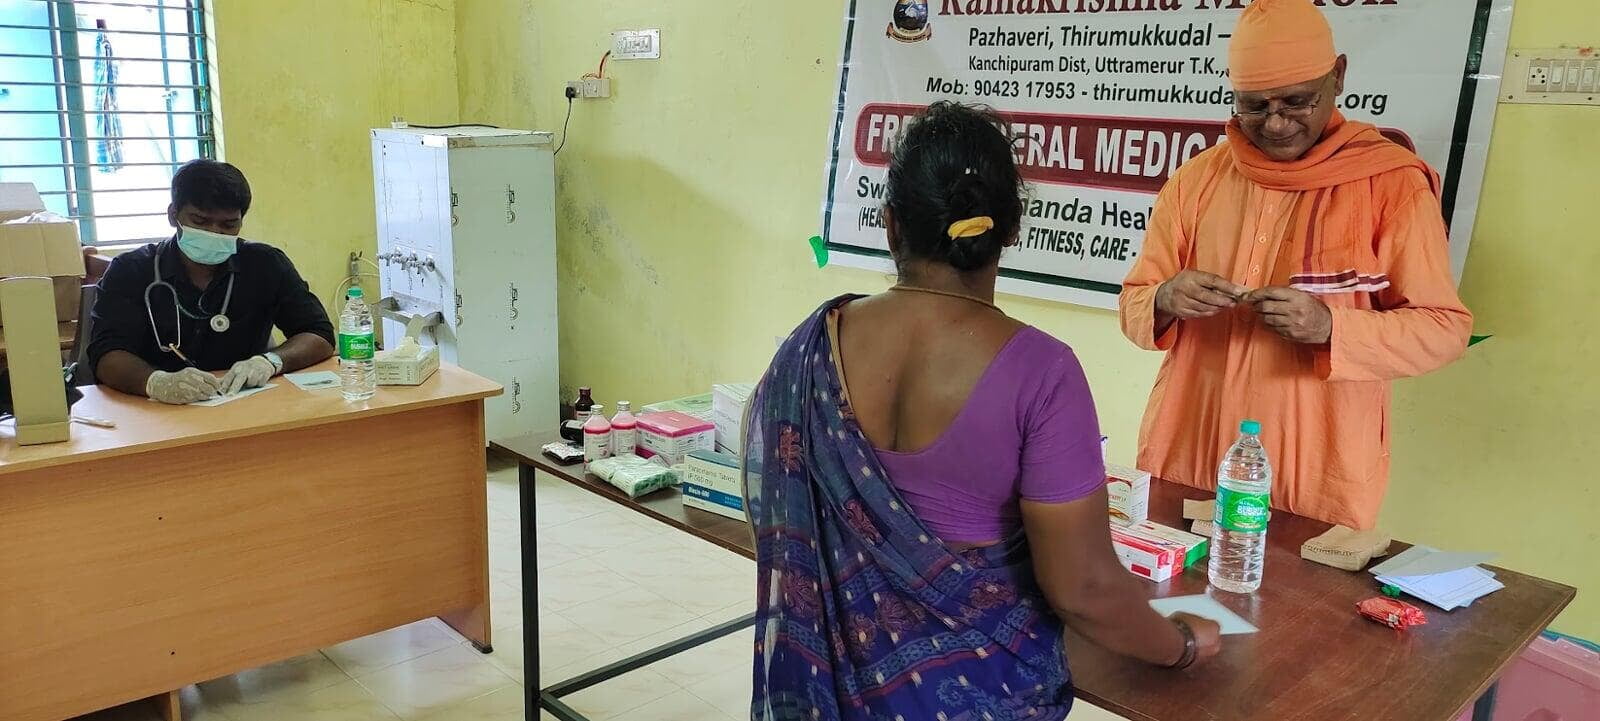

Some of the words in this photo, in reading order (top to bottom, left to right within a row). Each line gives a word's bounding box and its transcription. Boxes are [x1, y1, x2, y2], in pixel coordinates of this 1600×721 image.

[969, 26, 1054, 50] Pazhaveri,
[1060, 22, 1212, 47] Thirumukkudal
[968, 55, 1054, 73] Kanchipuram
[1059, 56, 1091, 76] Dist,
[1095, 57, 1184, 74] Uttramerur
[926, 77, 969, 97] Mob:
[974, 80, 1019, 98] 90423
[1026, 81, 1075, 99] 17953
[1093, 83, 1235, 105] thirumukkuda
[1027, 226, 1085, 260] FITNESS,
[1090, 235, 1130, 261] CARE
